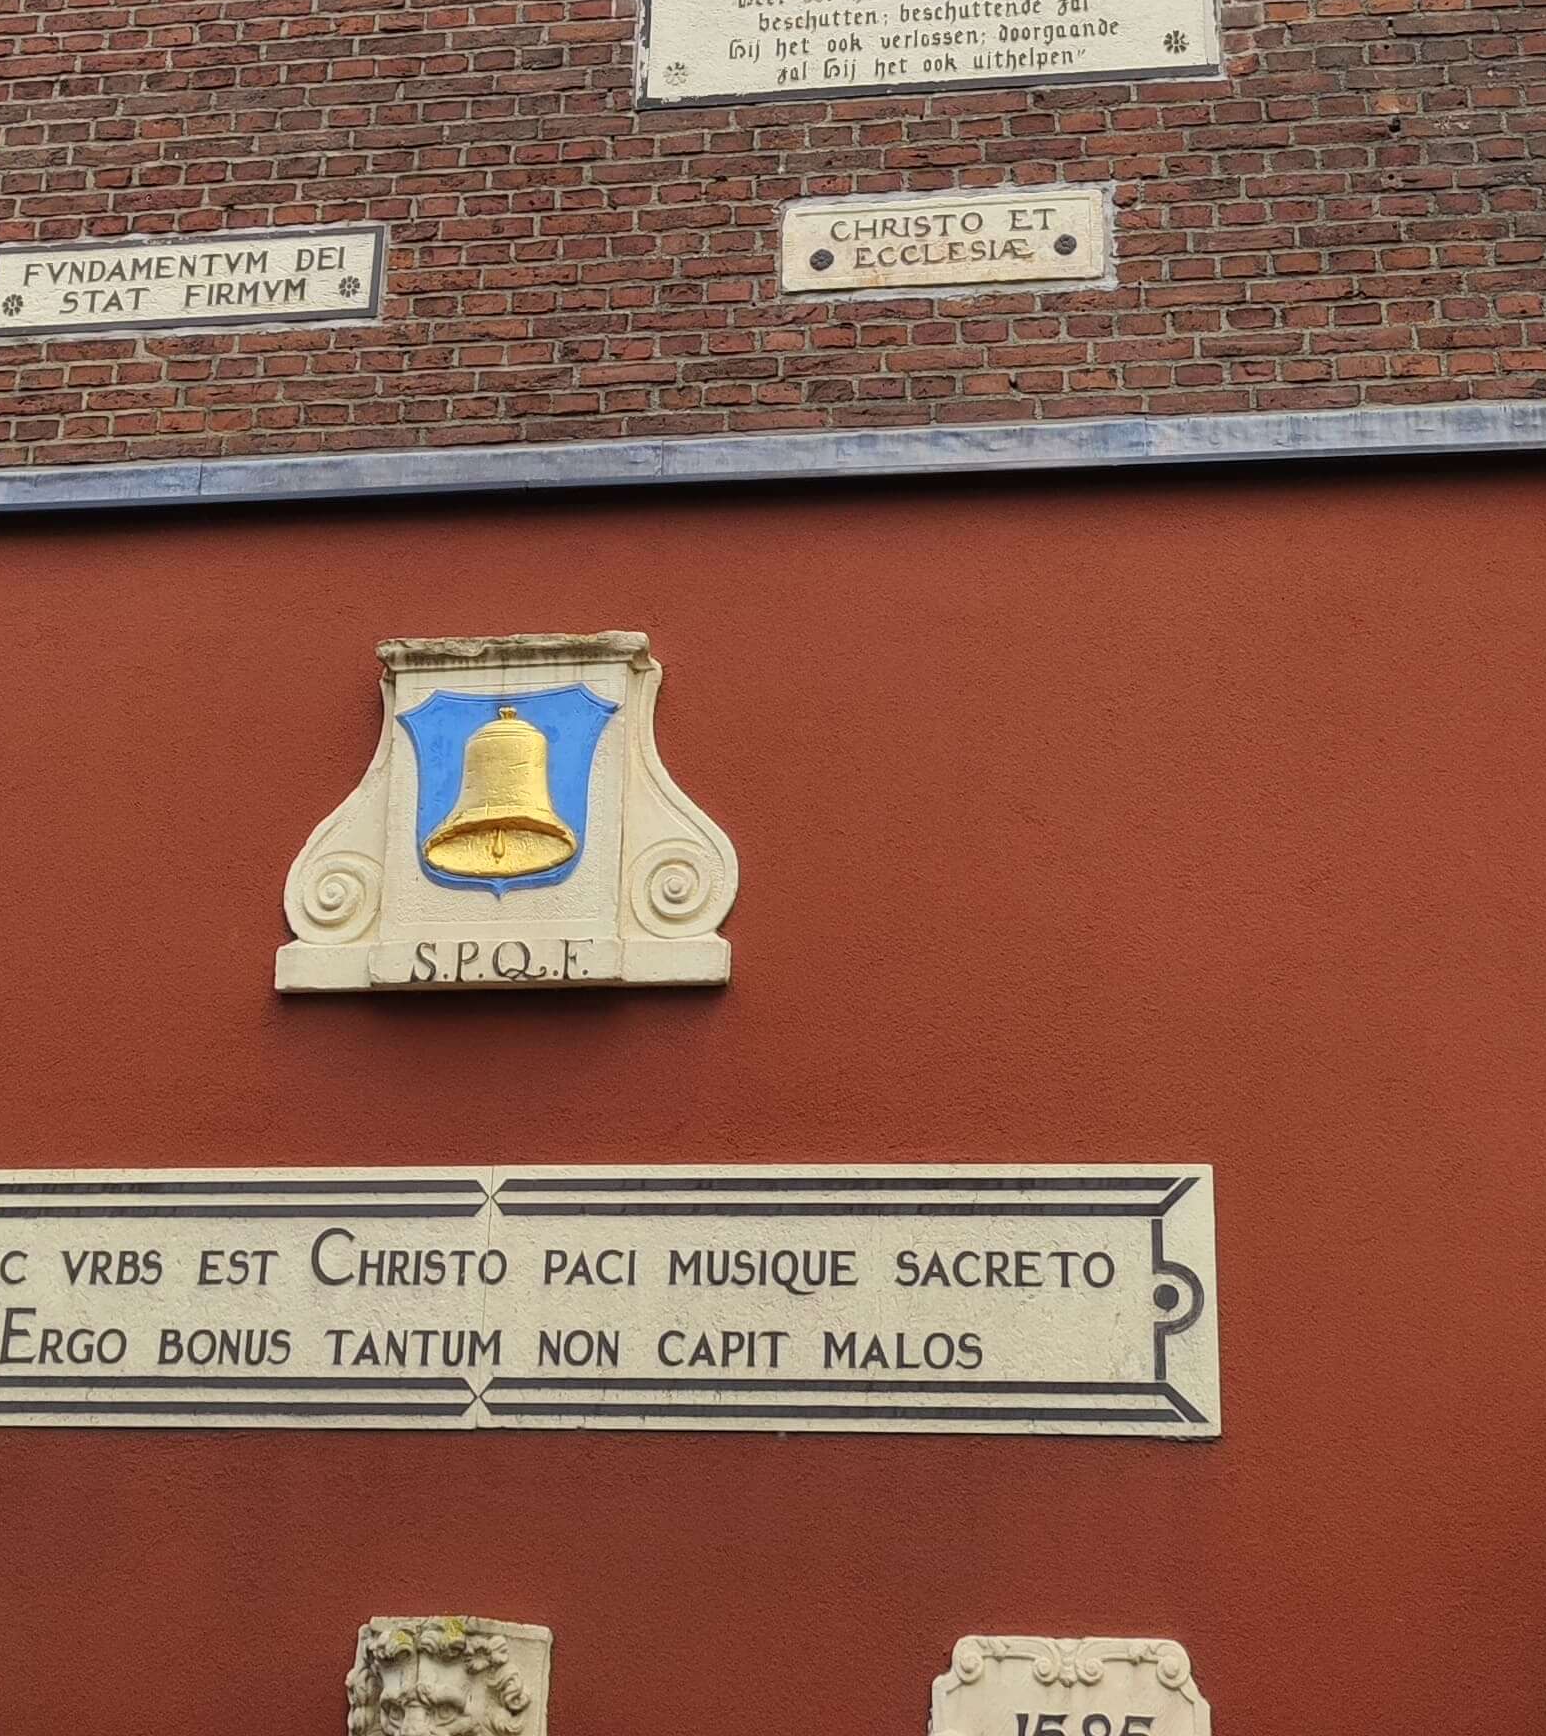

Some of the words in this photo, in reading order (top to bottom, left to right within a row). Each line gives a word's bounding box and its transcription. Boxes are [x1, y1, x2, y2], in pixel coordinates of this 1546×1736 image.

[776, 37, 810, 60] het
[827, 32, 862, 53] ook
[880, 26, 986, 50] verlossen;
[999, 18, 1120, 45] doorgaande
[777, 61, 807, 84] zal
[875, 56, 908, 80] het
[923, 55, 958, 72] ook
[831, 211, 983, 243] CHRISTO
[1009, 207, 1057, 231] ET
[23, 251, 269, 287] FVNDAMENTVM
[295, 246, 346, 272] DEI
[59, 287, 150, 314] STAT
[183, 278, 307, 308] FIRMVM
[61, 1249, 164, 1286] VRBS
[197, 1249, 279, 1286] EST
[311, 1227, 508, 1286] CHRISTO
[543, 1249, 637, 1287] PACI
[668, 1249, 859, 1295] MUSIQUE
[893, 1250, 1115, 1289] SACRETO
[158, 1328, 291, 1366] BONUS
[325, 1329, 503, 1365] TANTUM
[537, 1330, 620, 1367] NON
[657, 1330, 791, 1368] CAPIT
[823, 1331, 984, 1370] MALOS
